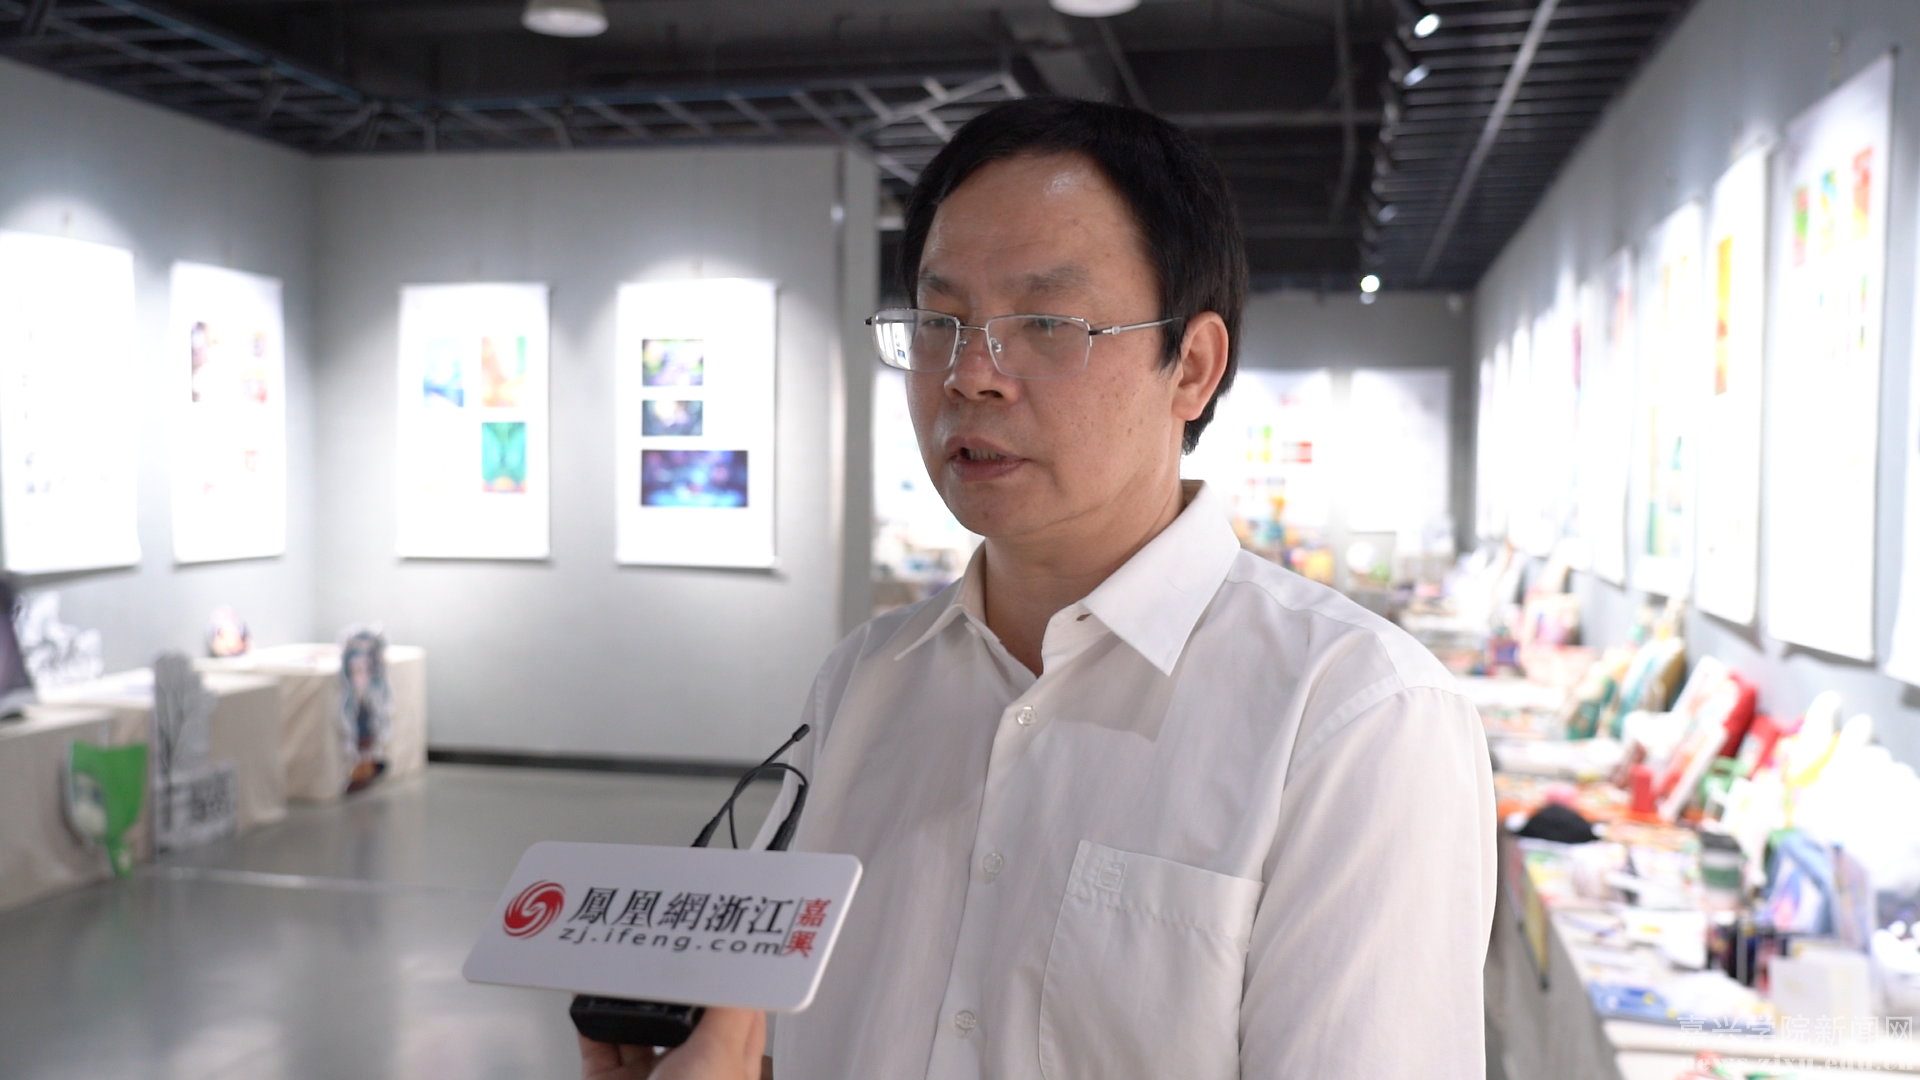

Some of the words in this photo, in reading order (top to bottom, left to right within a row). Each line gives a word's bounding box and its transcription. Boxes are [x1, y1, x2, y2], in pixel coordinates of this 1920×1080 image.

[567, 887, 793, 935] 鳳凰網浙江
[558, 926, 781, 955] zj.ifeng.com
